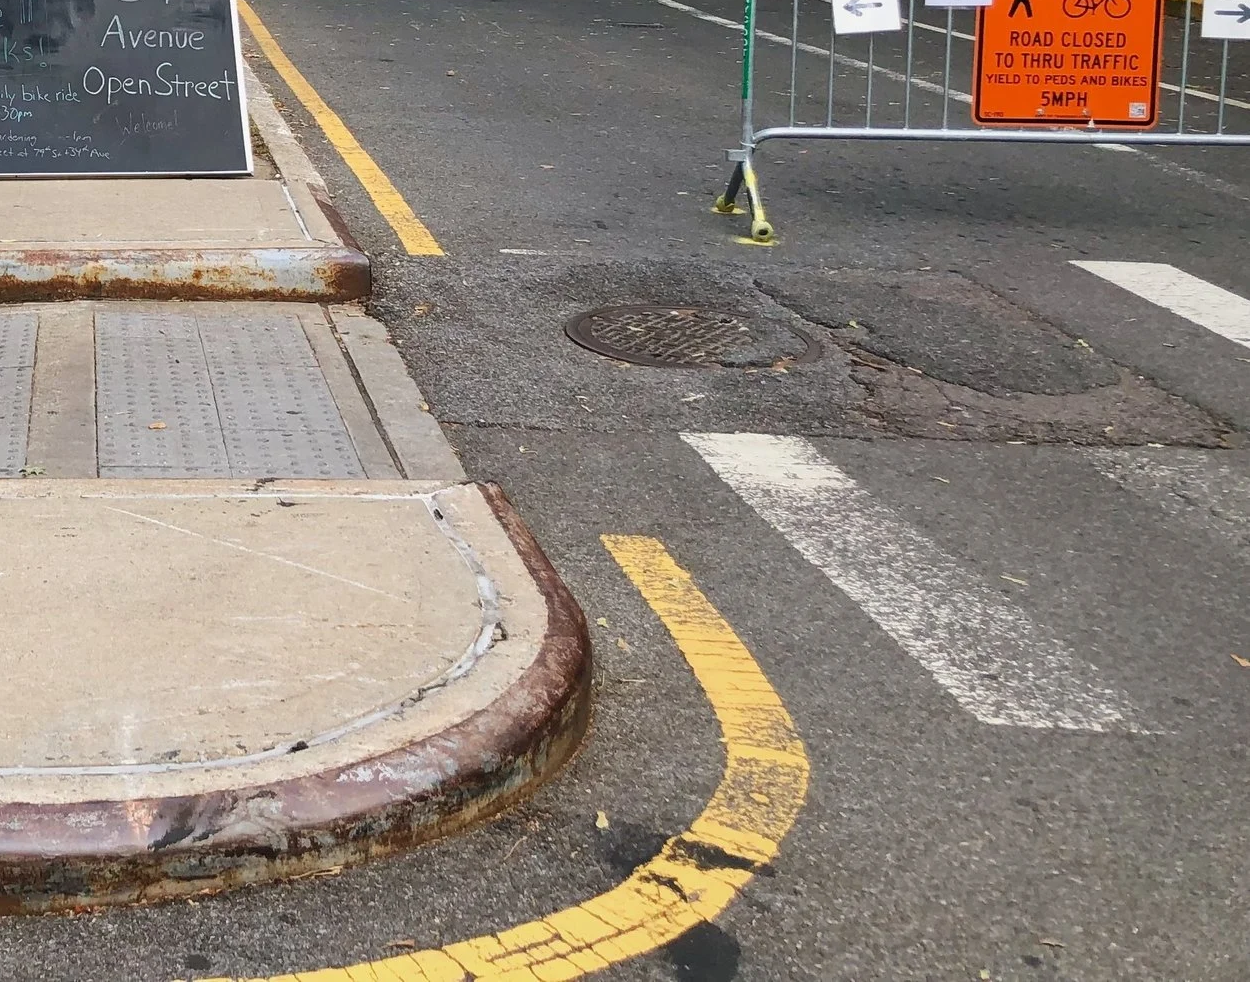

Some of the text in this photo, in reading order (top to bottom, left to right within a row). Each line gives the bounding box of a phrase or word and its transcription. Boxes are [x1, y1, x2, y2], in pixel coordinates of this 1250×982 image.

[100, 14, 205, 50] Avenue
[1009, 30, 1127, 49] ROAD CLOSED
[995, 52, 1140, 71] TO THRU TRAFFIC
[985, 73, 1148, 87] YIELD TO PEDS AND BIKES
[22, 84, 51, 103] bike
[55, 82, 81, 103] ride
[1041, 90, 1088, 107] 5MPH
